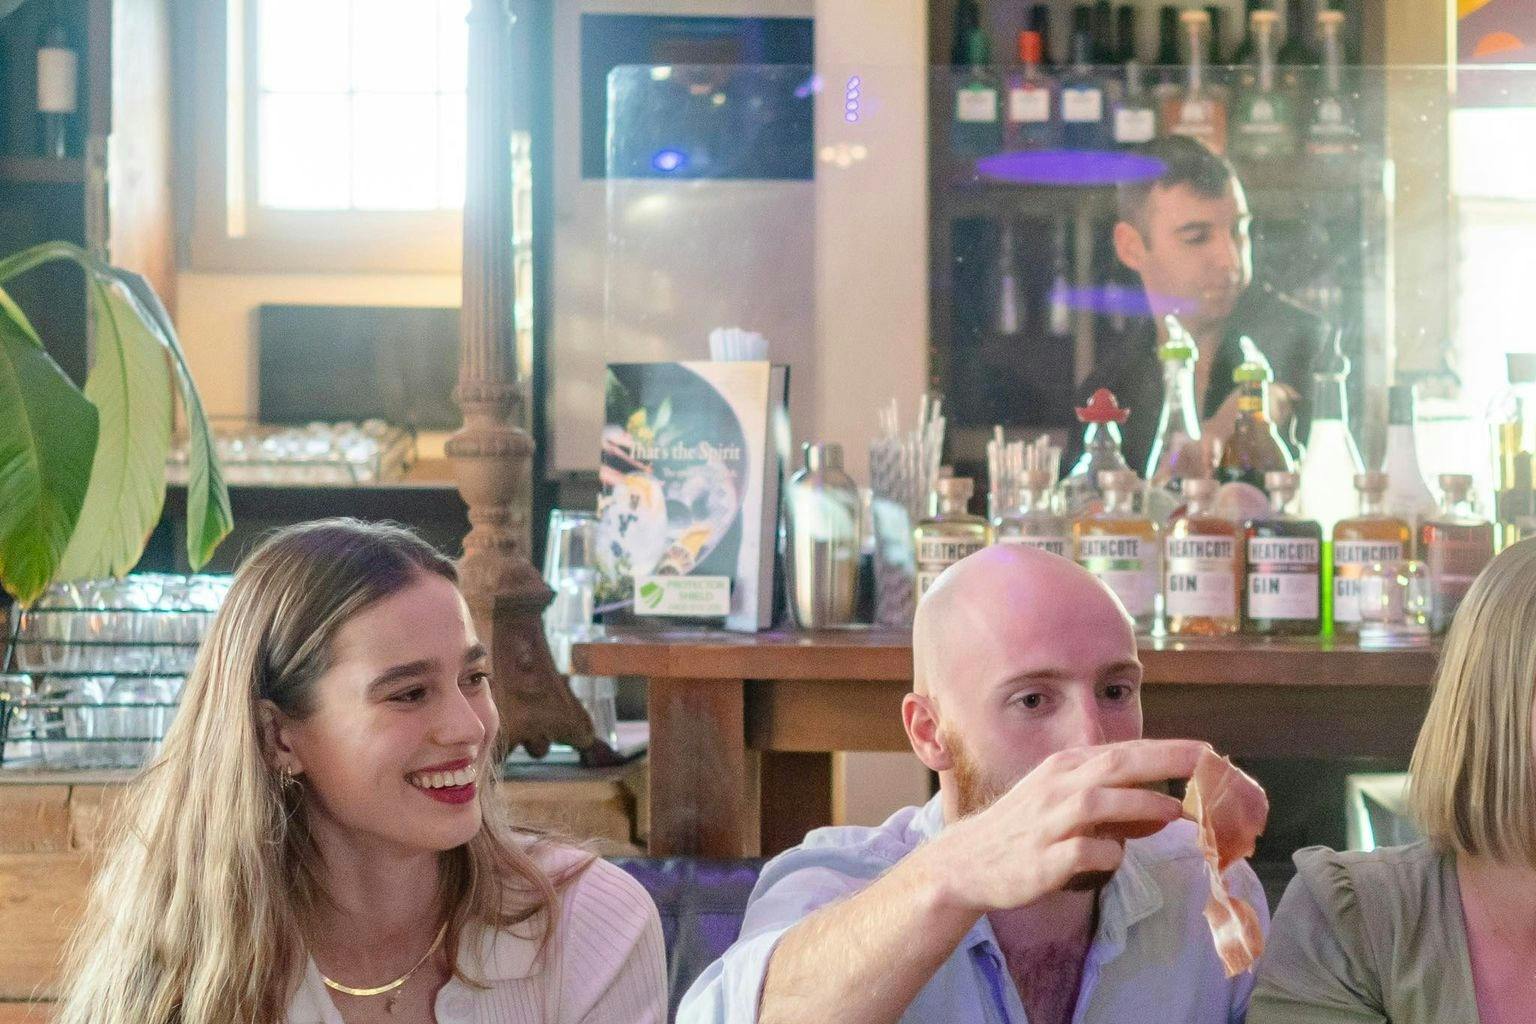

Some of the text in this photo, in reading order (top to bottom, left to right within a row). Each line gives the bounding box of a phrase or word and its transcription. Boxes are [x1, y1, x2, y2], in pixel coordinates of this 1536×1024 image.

[672, 441, 693, 460] the
[698, 441, 740, 463] Spirit
[1169, 540, 1232, 559] HEATHCOTE
[1251, 542, 1316, 561] HEATHCOTE
[1169, 575, 1197, 592] GIN
[1252, 578, 1280, 595] GIN
